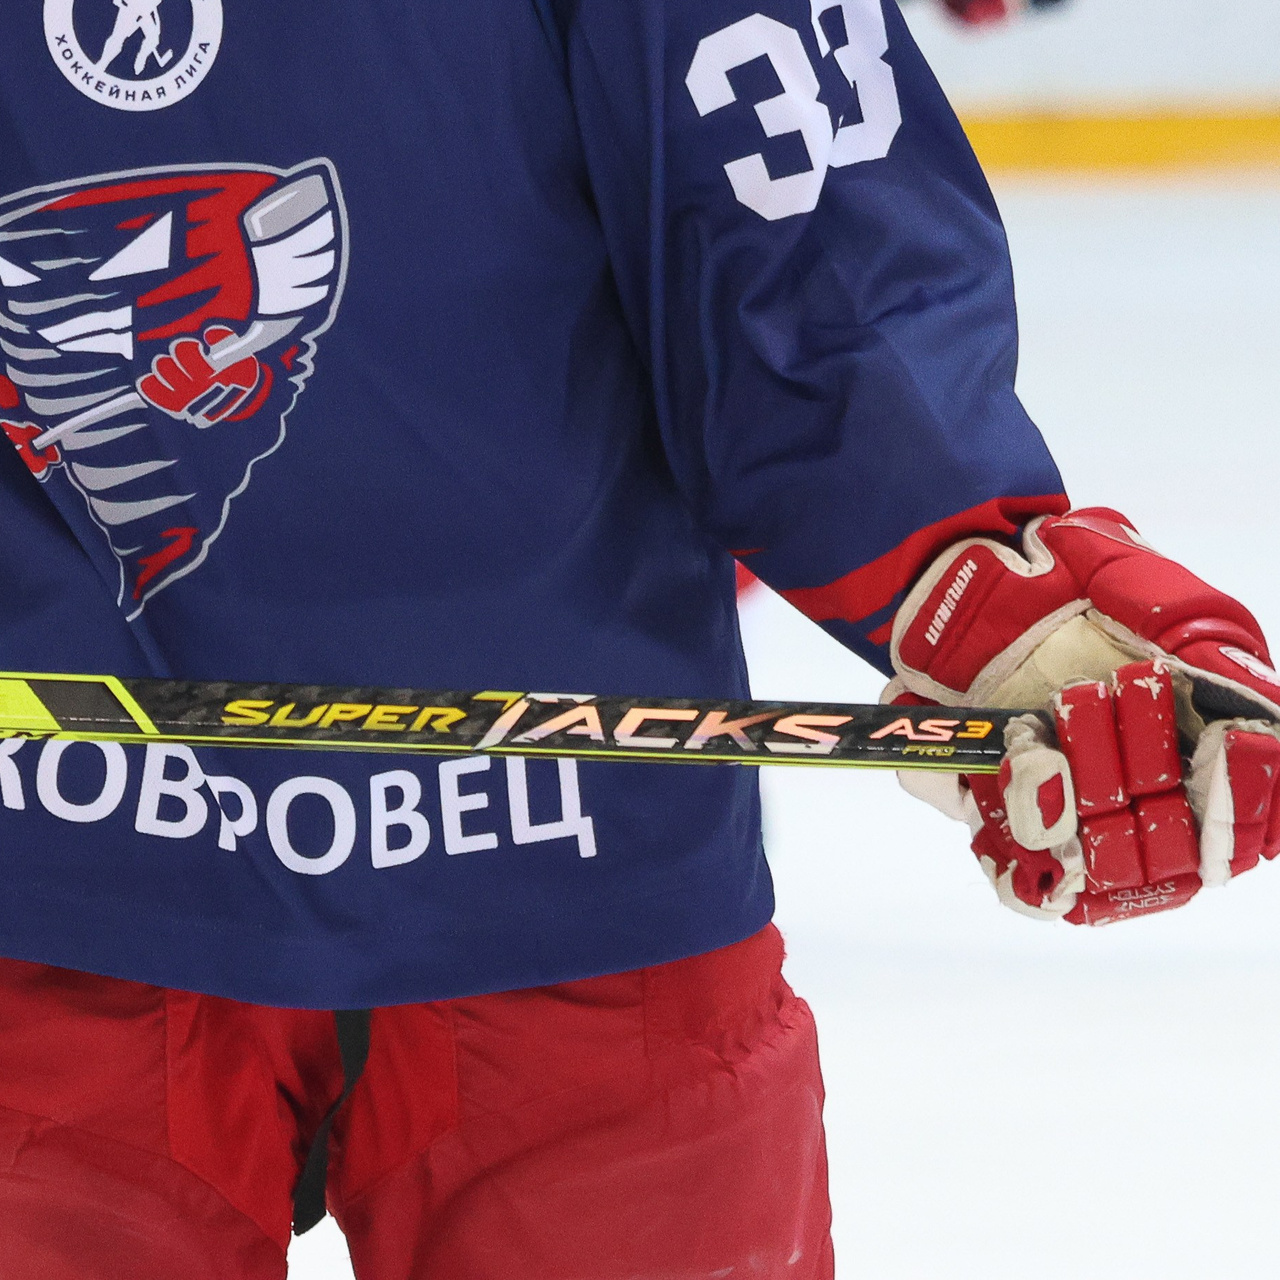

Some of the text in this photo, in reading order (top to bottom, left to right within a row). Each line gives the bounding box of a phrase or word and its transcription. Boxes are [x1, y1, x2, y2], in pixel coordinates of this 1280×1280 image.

[55, 34, 211, 102] ХОККЕЙНАЯ ЛИГА
[222, 690, 994, 755] SUPER TACKS AS3
